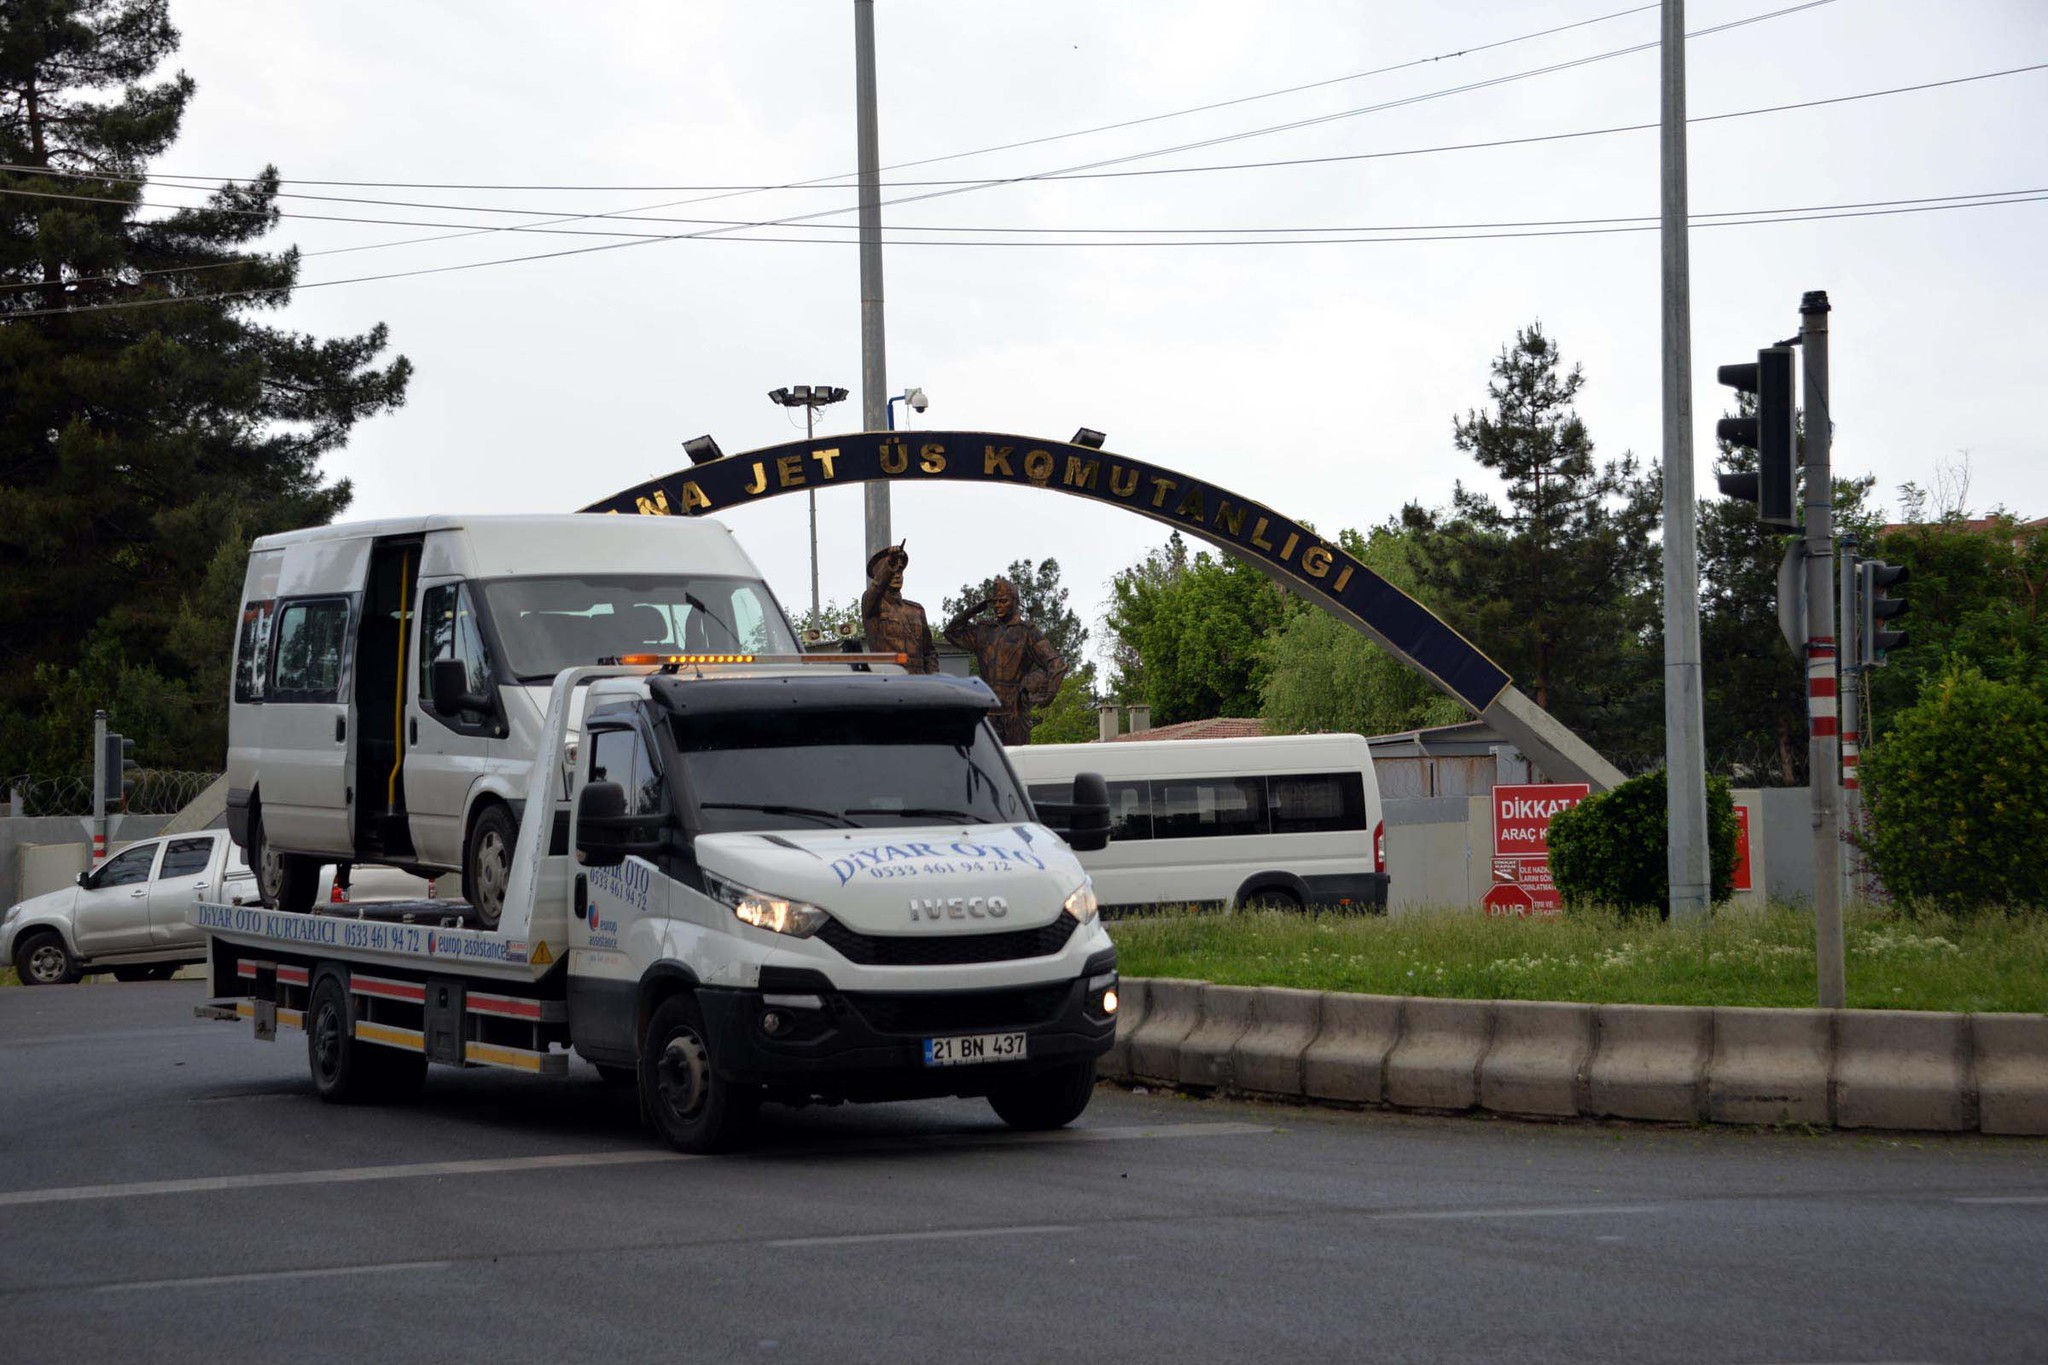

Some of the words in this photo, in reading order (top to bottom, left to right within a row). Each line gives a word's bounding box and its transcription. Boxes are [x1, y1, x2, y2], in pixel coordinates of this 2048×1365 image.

[606, 481, 712, 515] NA
[744, 448, 841, 495] JET
[879, 437, 947, 475] ÜS
[1501, 828, 1536, 843] ARAÇ
[870, 864, 917, 879] 0533
[923, 863, 955, 875] 461
[960, 861, 984, 873] 94
[988, 860, 1012, 872] 72
[950, 842, 1046, 870] OTO
[590, 869, 608, 890] 0533
[610, 881, 623, 899] 461
[625, 886, 635, 905] 94
[637, 893, 647, 911] 72
[626, 860, 649, 893] OTO
[909, 896, 1008, 921] IVECO
[236, 909, 261, 932] OTO
[266, 916, 336, 943] KURTARICI
[344, 924, 368, 947] 0533
[371, 927, 388, 950] 461
[392, 929, 405, 952] 94
[408, 930, 420, 953] 72
[438, 935, 461, 959] europ
[464, 938, 506, 961] assistance
[934, 1040, 951, 1059] 21
[961, 1038, 984, 1057] BN
[993, 1035, 1023, 1054] 437
